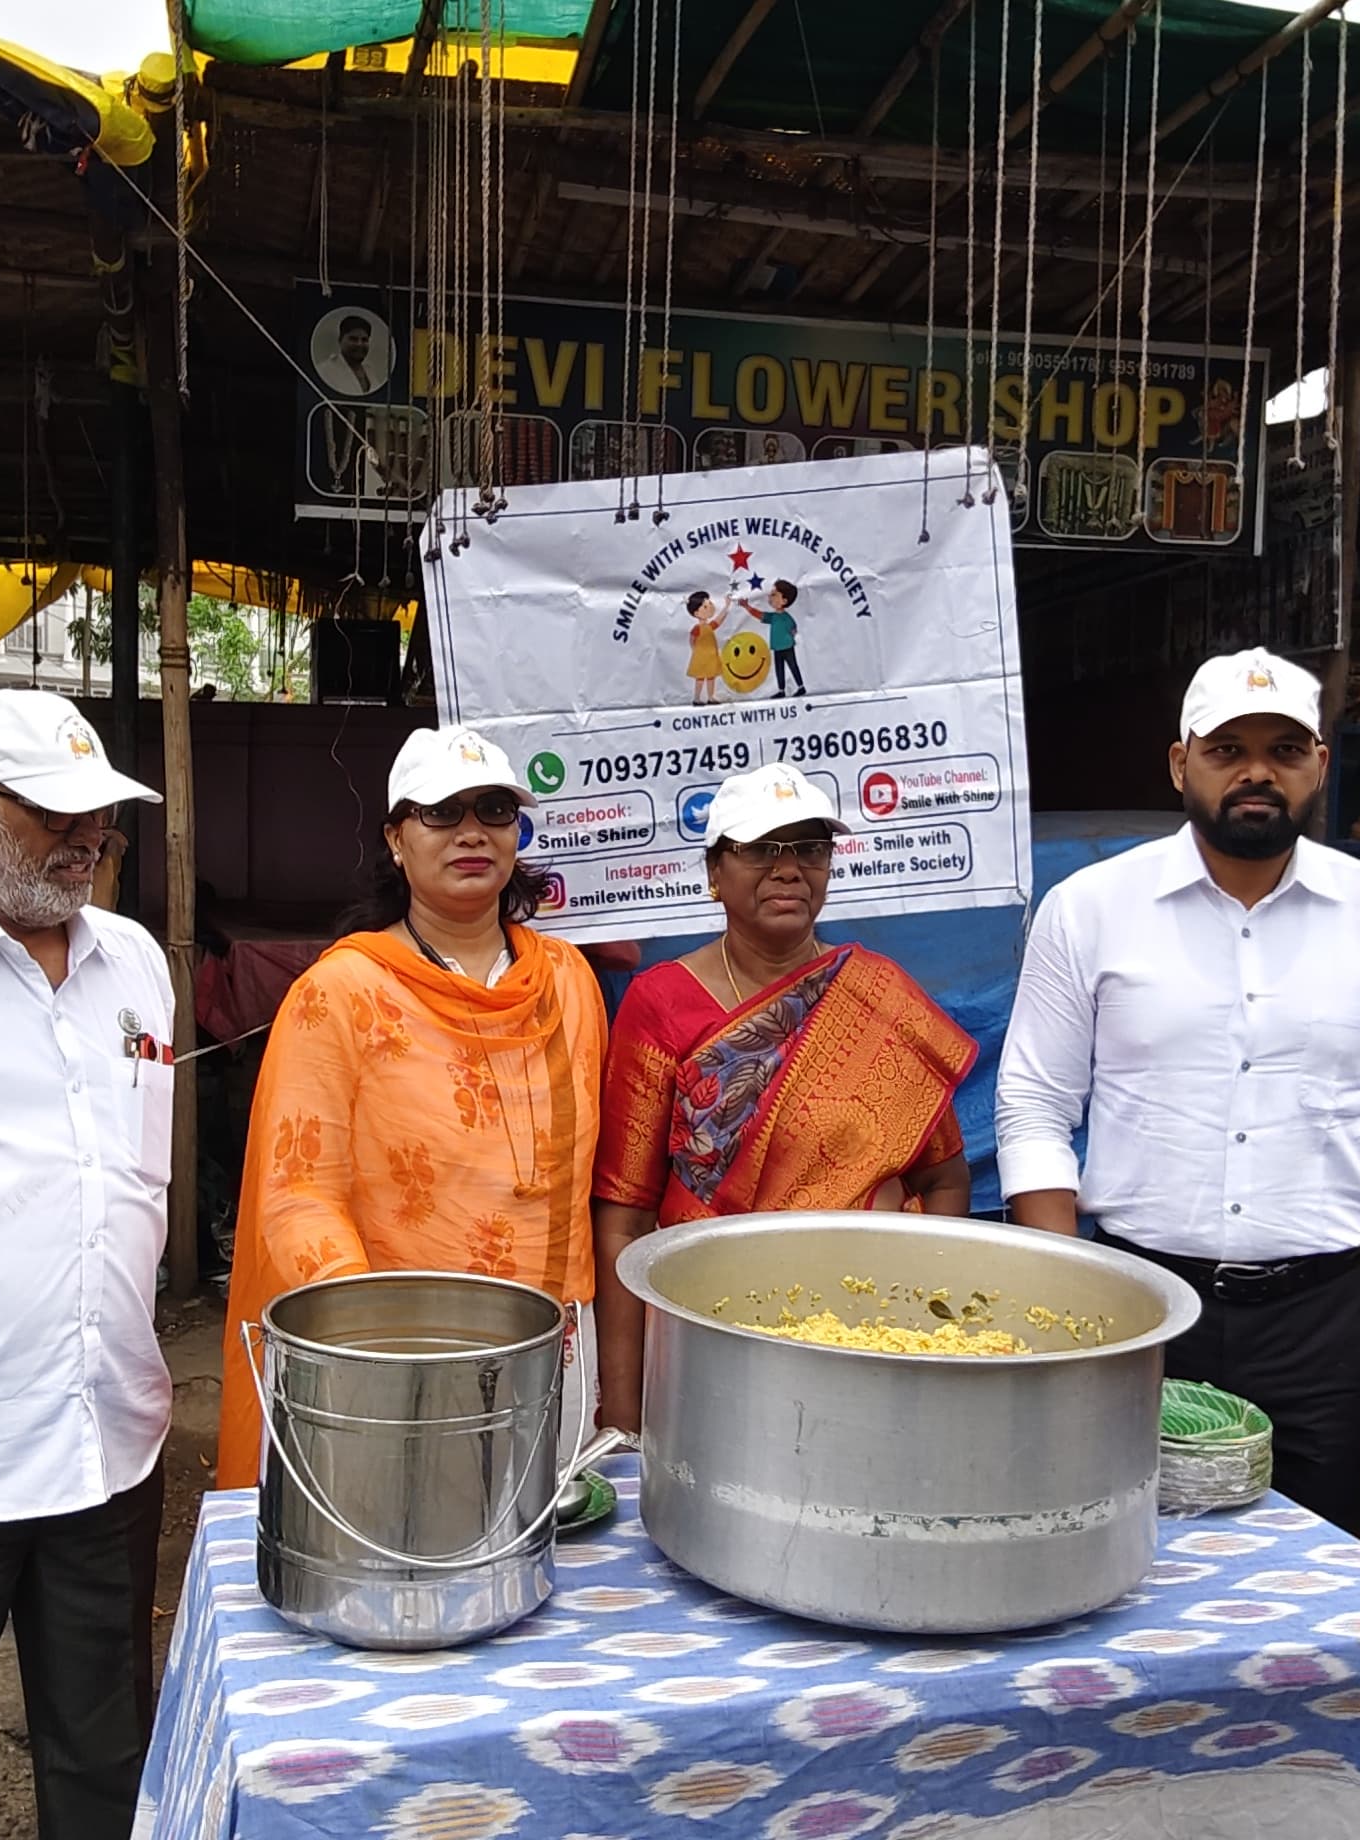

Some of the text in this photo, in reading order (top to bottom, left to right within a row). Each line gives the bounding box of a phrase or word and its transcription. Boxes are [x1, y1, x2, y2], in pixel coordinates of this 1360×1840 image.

[411, 327, 1187, 449] DEVI FLOWER SHOP
[613, 517, 873, 643] SMILE WITH SHINE WELFARE SOCIETY
[672, 705, 798, 731] CONTACT WITH US
[578, 742, 751, 787] 7093737459
[773, 720, 948, 763] 7396096830
[900, 769, 988, 790] YouTube Channel:
[900, 788, 996, 810] Smile With Shine
[545, 803, 633, 826] Facebook:
[537, 826, 650, 850] Smile Shine
[873, 833, 915, 852] Smile
[918, 830, 952, 847] with
[604, 859, 687, 882] Instagram:
[849, 859, 906, 878] Welfare
[909, 853, 966, 873] Society
